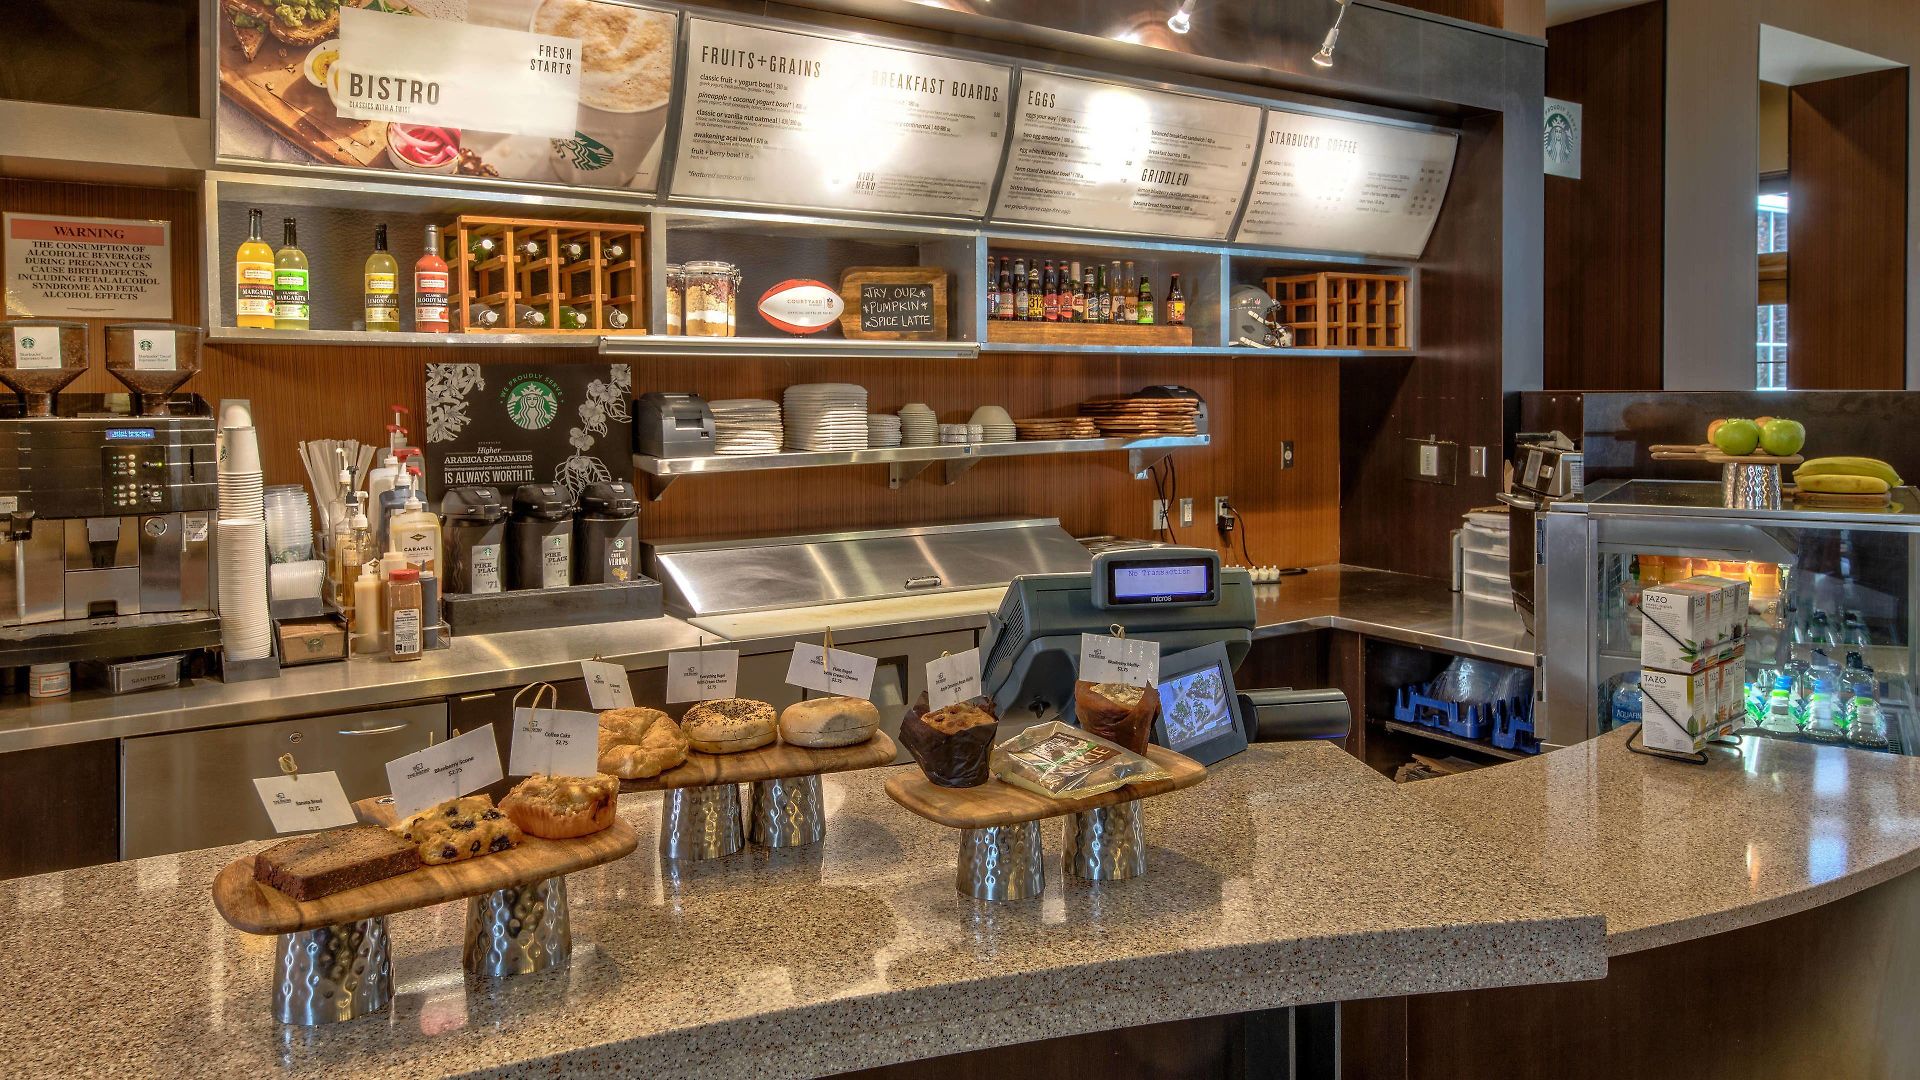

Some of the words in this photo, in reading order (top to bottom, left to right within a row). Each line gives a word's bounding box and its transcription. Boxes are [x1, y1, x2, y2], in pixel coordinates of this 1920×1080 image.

[540, 44, 572, 61] FRESH
[530, 59, 571, 75] STARTS
[701, 45, 820, 78] FRUITS+GRAINS
[700, 74, 719, 82] classic
[720, 75, 733, 83] fruit
[739, 78, 757, 87] yogurt
[758, 80, 773, 88] bowl
[873, 71, 944, 95] BREAKFAST
[952, 81, 999, 102] BOARDS
[349, 73, 440, 105] BISTRO
[349, 101, 373, 110] CLASSICS
[697, 91, 727, 101] pineapple
[733, 95, 756, 104] coconut
[756, 98, 775, 107] yogurt
[1028, 91, 1056, 108] EGGS
[697, 109, 716, 117] classic
[724, 112, 742, 120] vanilla
[755, 114, 778, 123] oatmeal
[693, 132, 725, 142] awakening
[739, 135, 753, 143] bowl
[1270, 130, 1320, 150] STARBUCKS
[691, 147, 704, 155] fruit
[710, 149, 726, 157] berry
[1039, 168, 1059, 176] breakfast
[1141, 168, 1189, 186] GRIDDLED
[1024, 185, 1044, 193] breakfast
[54, 226, 125, 239] WARNING
[32, 240, 53, 248] THE
[56, 241, 129, 252] CONSUMPTION
[27, 249, 89, 259] ALCOHOLIC
[92, 252, 151, 261] BEVERAGES
[25, 257, 66, 266] DURING
[68, 259, 130, 269] PREGNANCY
[132, 262, 153, 270] CAN
[31, 266, 65, 274] CAUSE
[68, 267, 98, 276] BIRTH
[18, 273, 76, 282] INCLUDING
[79, 275, 110, 284] FETAL
[112, 277, 160, 286] ALCOHOL
[32, 282, 91, 291] SYNDROME
[93, 284, 113, 292] AND
[116, 285, 147, 293] FETAL
[867, 287, 887, 298] TRY
[894, 287, 919, 299] OUR
[42, 290, 92, 299] ALCOHOL
[95, 292, 138, 300] EFFECTS
[870, 300, 919, 314] PUMPKIN
[870, 316, 898, 328] SPICE
[901, 315, 930, 328] LATTE
[500, 386, 509, 398] WE
[508, 373, 543, 387] PROUDLY
[477, 446, 502, 455] Higher
[444, 456, 483, 464] ARABICA
[483, 455, 533, 463] STANDARDS
[444, 472, 453, 484] IS
[456, 471, 490, 484] ALWAYS
[492, 470, 523, 482] WORTH
[525, 470, 535, 481] IT.
[1142, 568, 1191, 577] Transaction
[1646, 594, 1667, 604] TAZO
[131, 674, 167, 685] SANITIZER
[1644, 674, 1667, 684] TAZO
[1617, 709, 1642, 720] AQUAFIN
[434, 762, 459, 774] Blueberry
[459, 756, 474, 765] Scone
